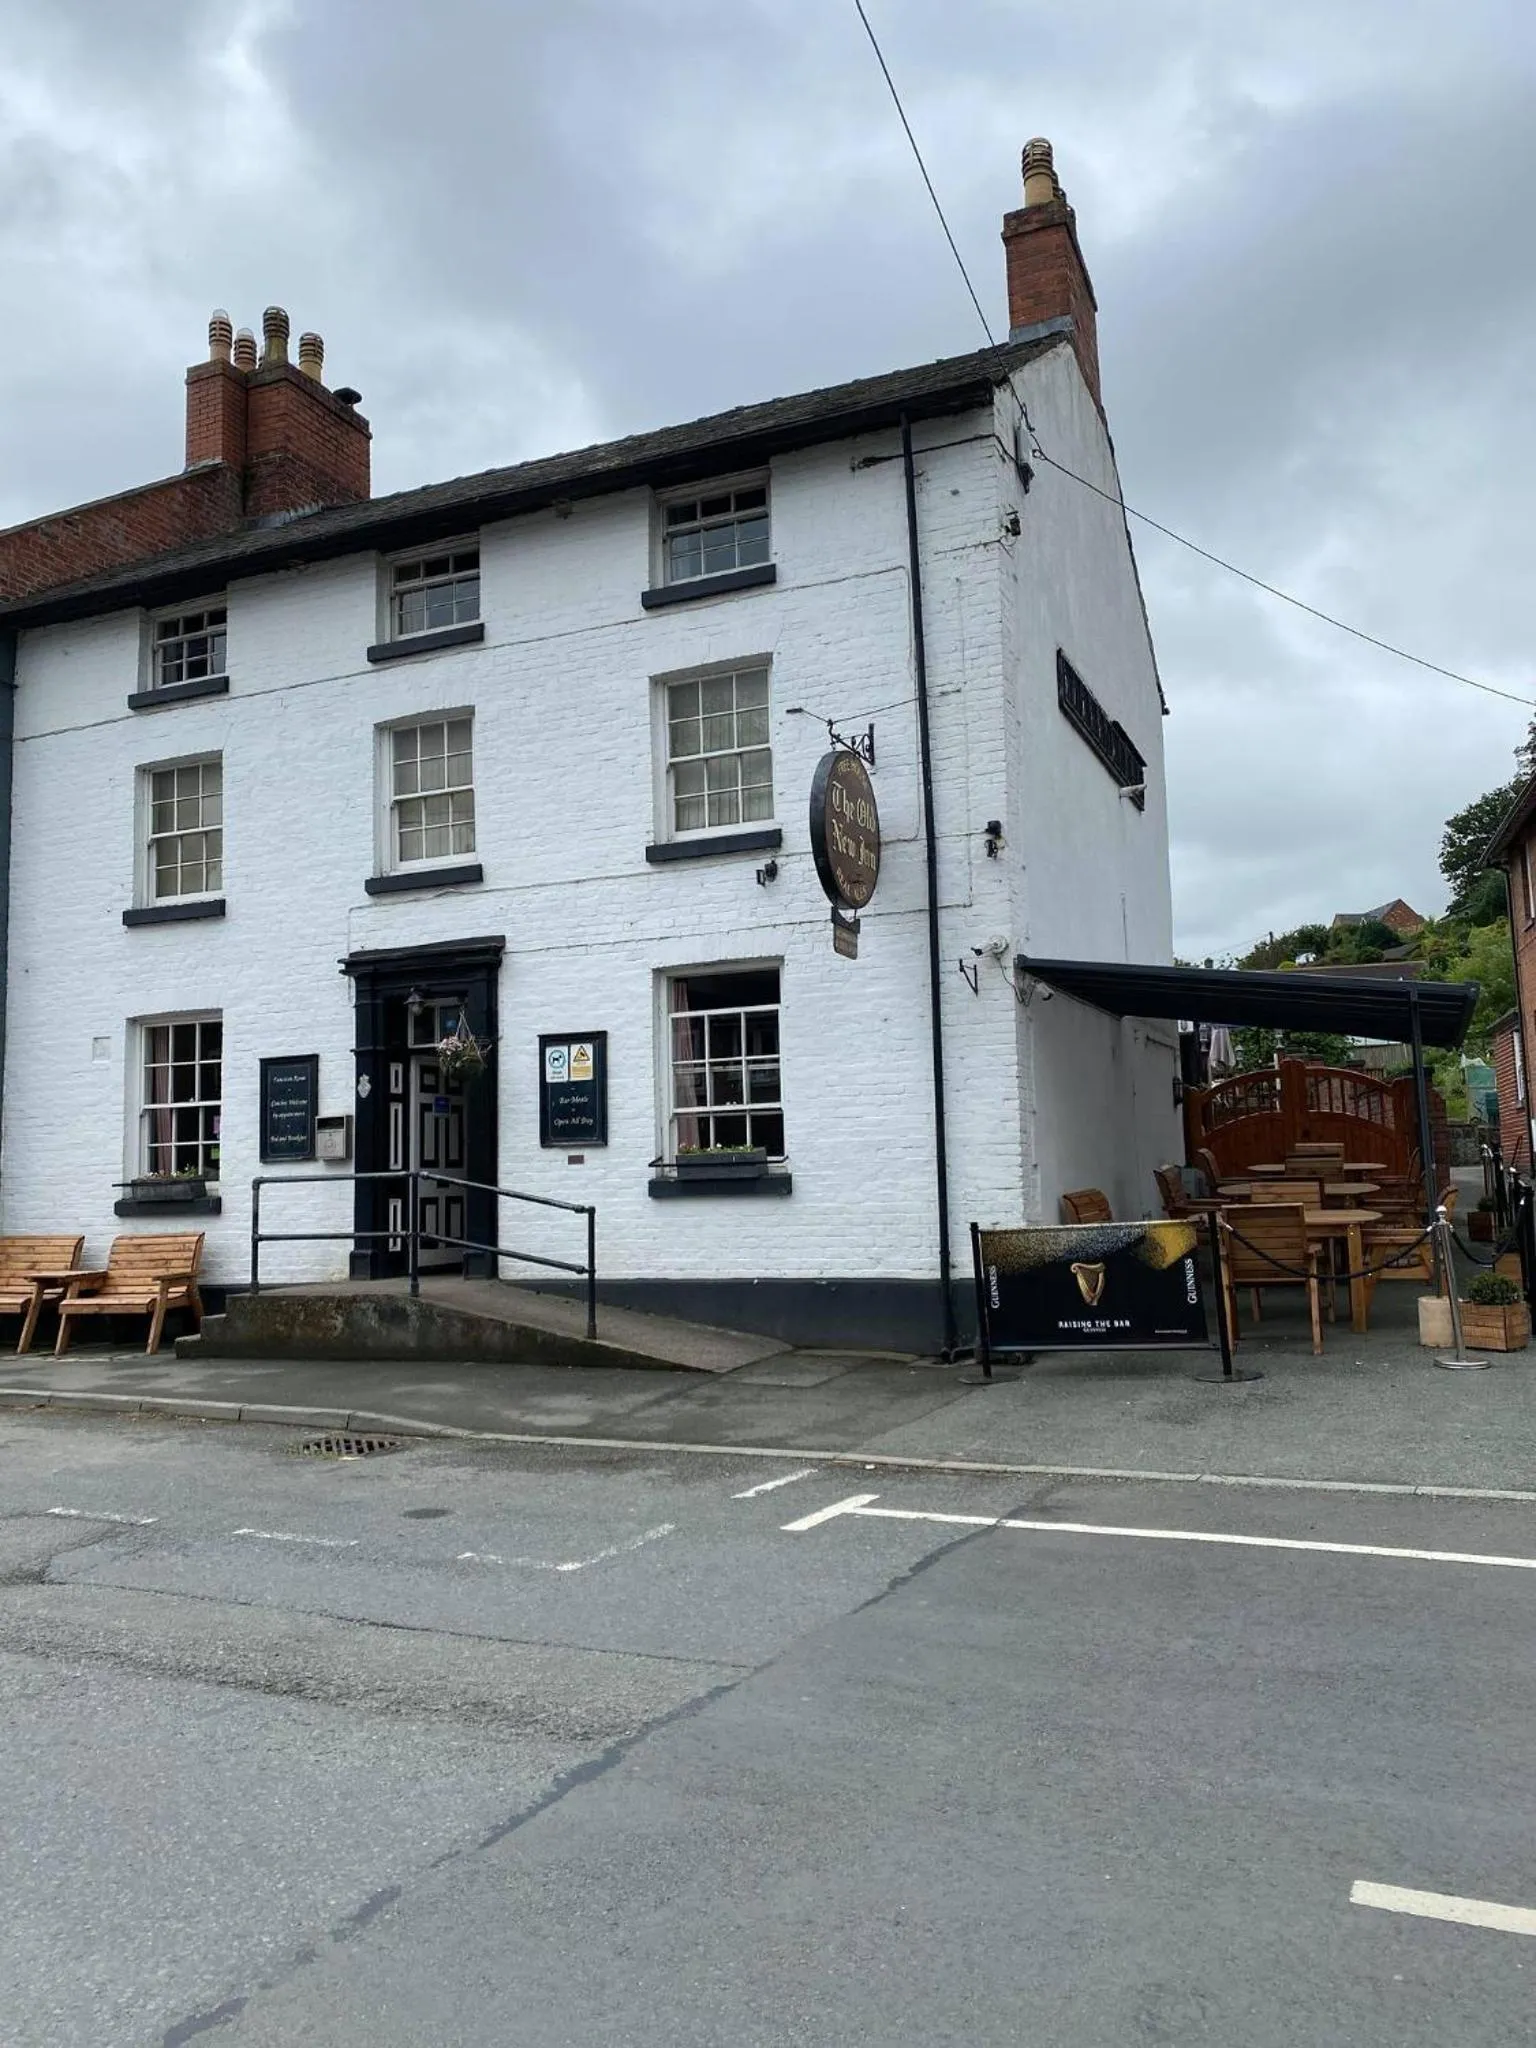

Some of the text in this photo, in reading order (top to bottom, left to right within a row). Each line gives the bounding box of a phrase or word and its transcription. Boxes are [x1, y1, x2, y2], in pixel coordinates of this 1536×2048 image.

[832, 780, 876, 832] The Old
[832, 818, 876, 871] New Inn
[990, 1264, 1000, 1309] GUINNESS
[1184, 1258, 1198, 1304] GUINNESS
[1058, 1319, 1131, 1328] RAISING THE BAR
